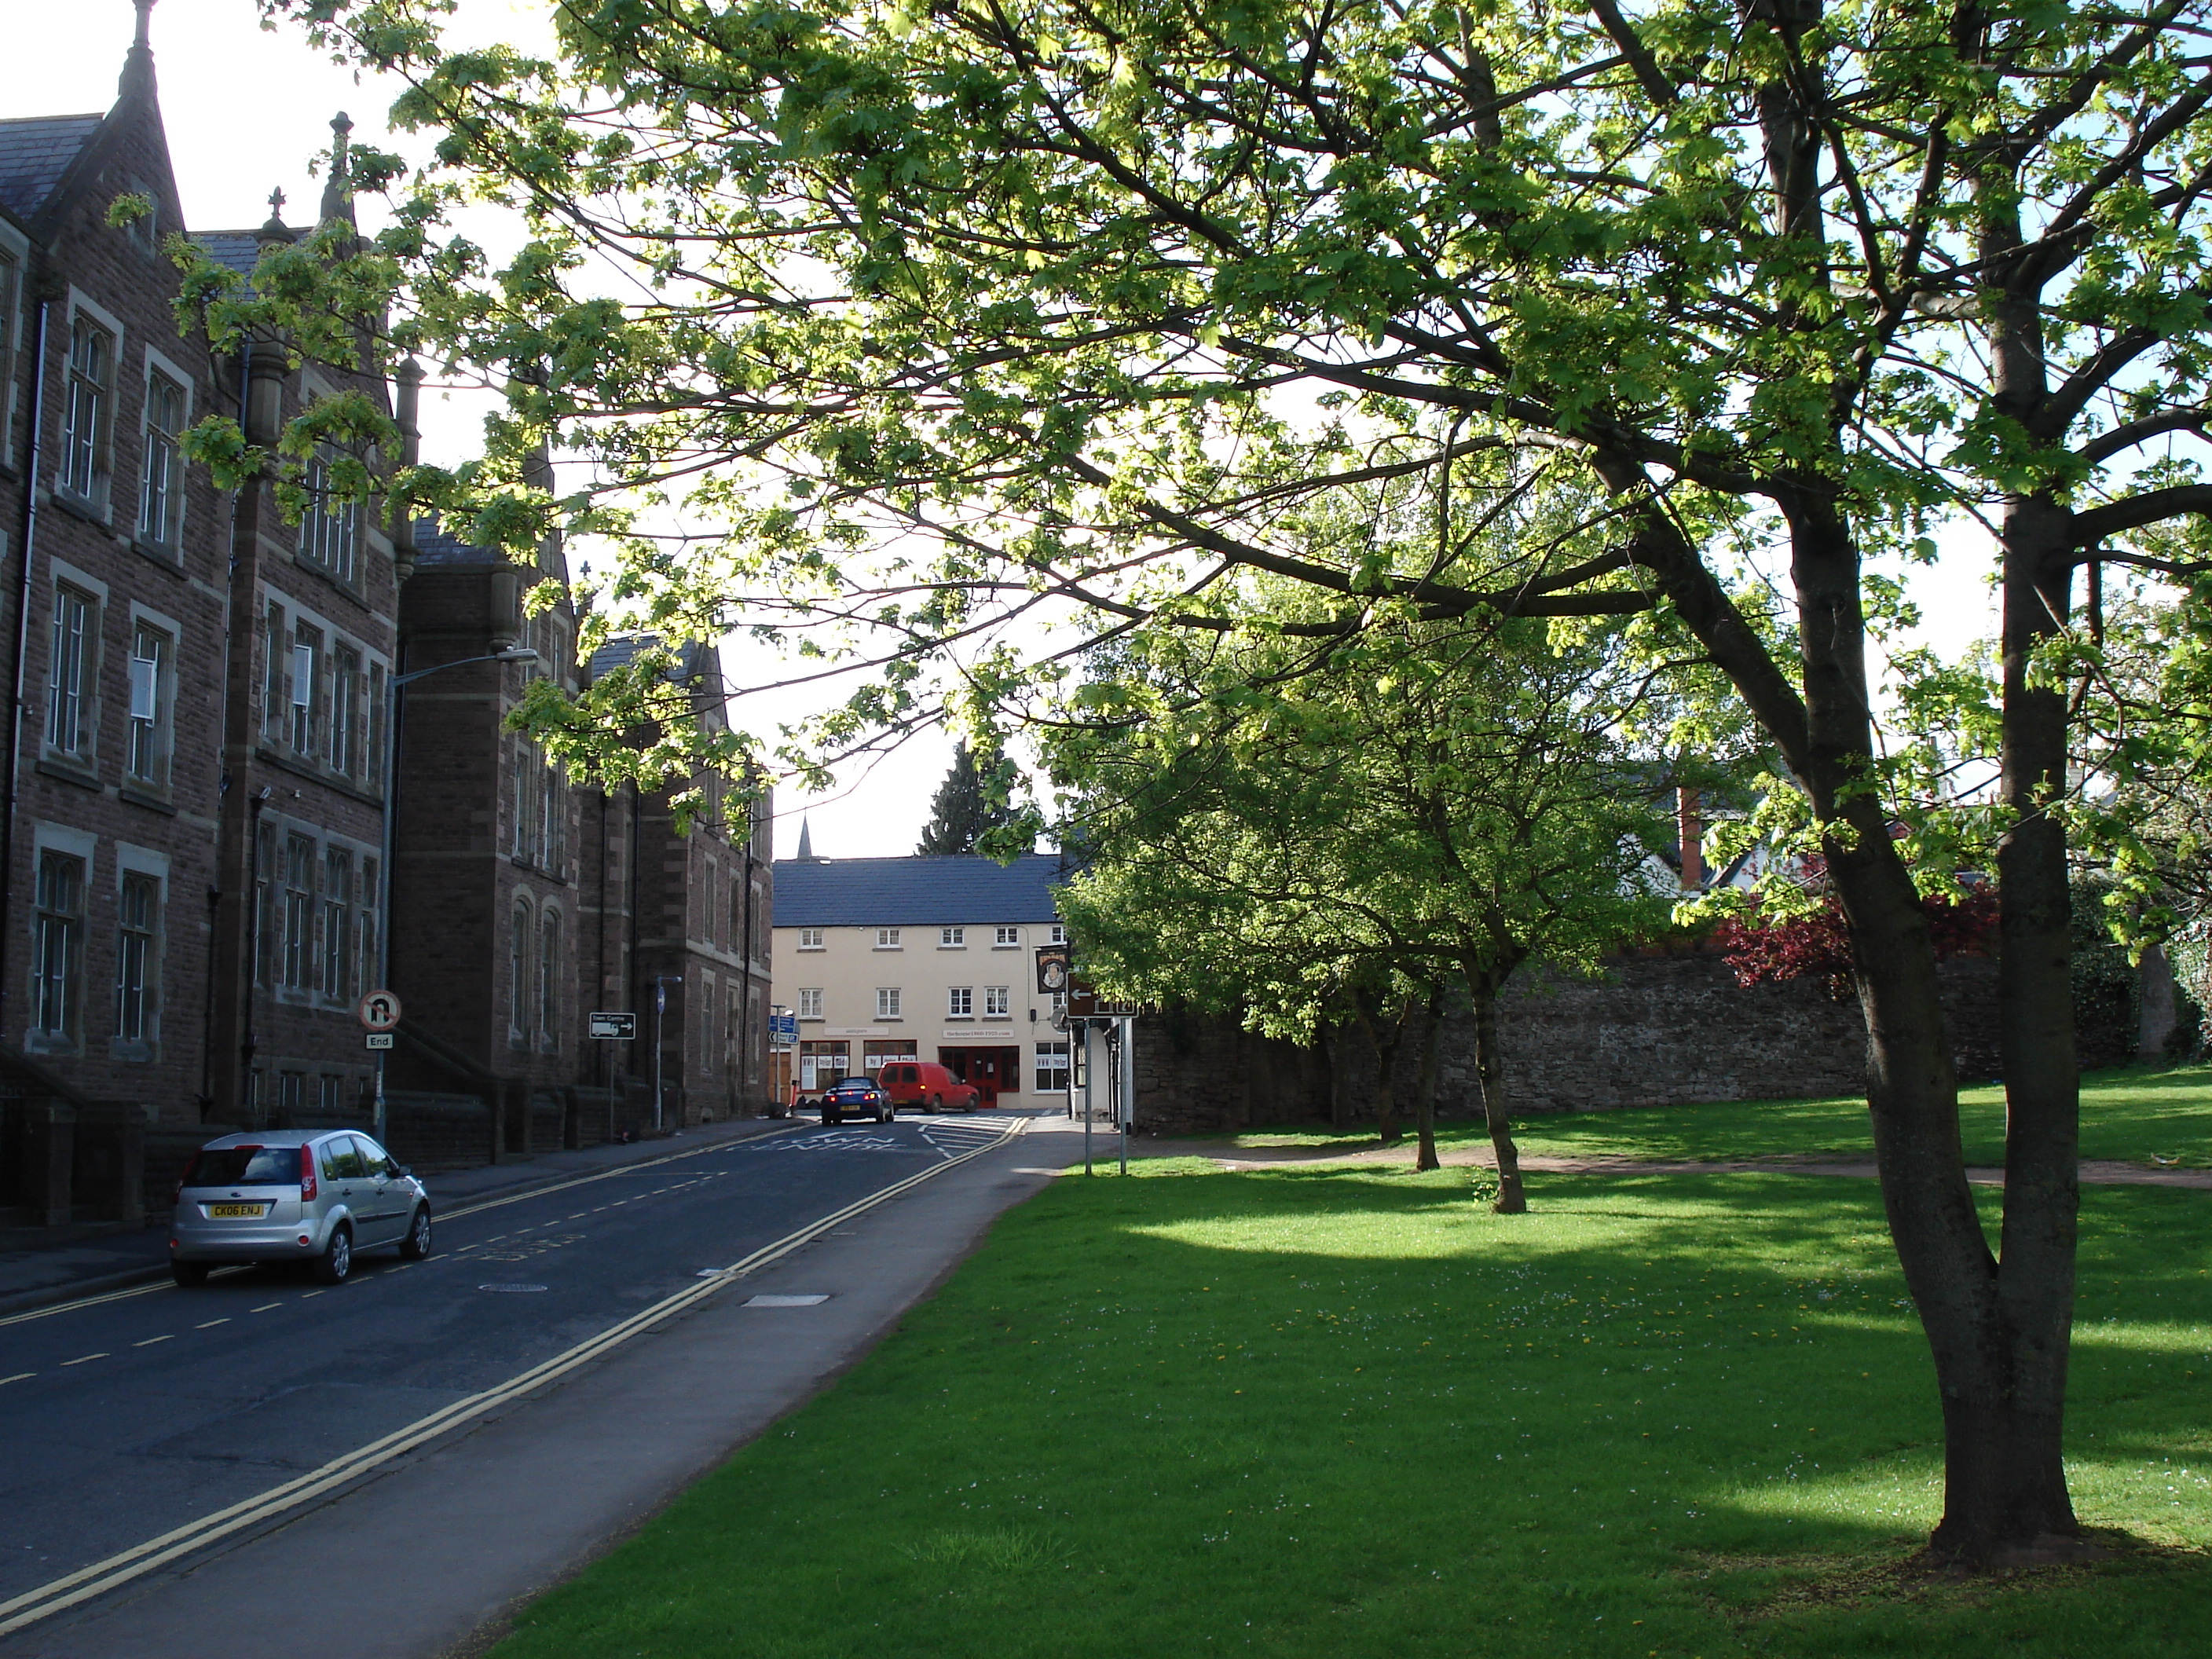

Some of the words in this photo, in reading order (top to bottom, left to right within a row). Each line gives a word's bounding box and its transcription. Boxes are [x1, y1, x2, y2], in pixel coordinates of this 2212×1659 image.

[370, 1037, 389, 1046] End
[214, 1206, 239, 1216] CK06
[241, 1205, 260, 1215] ENJ
